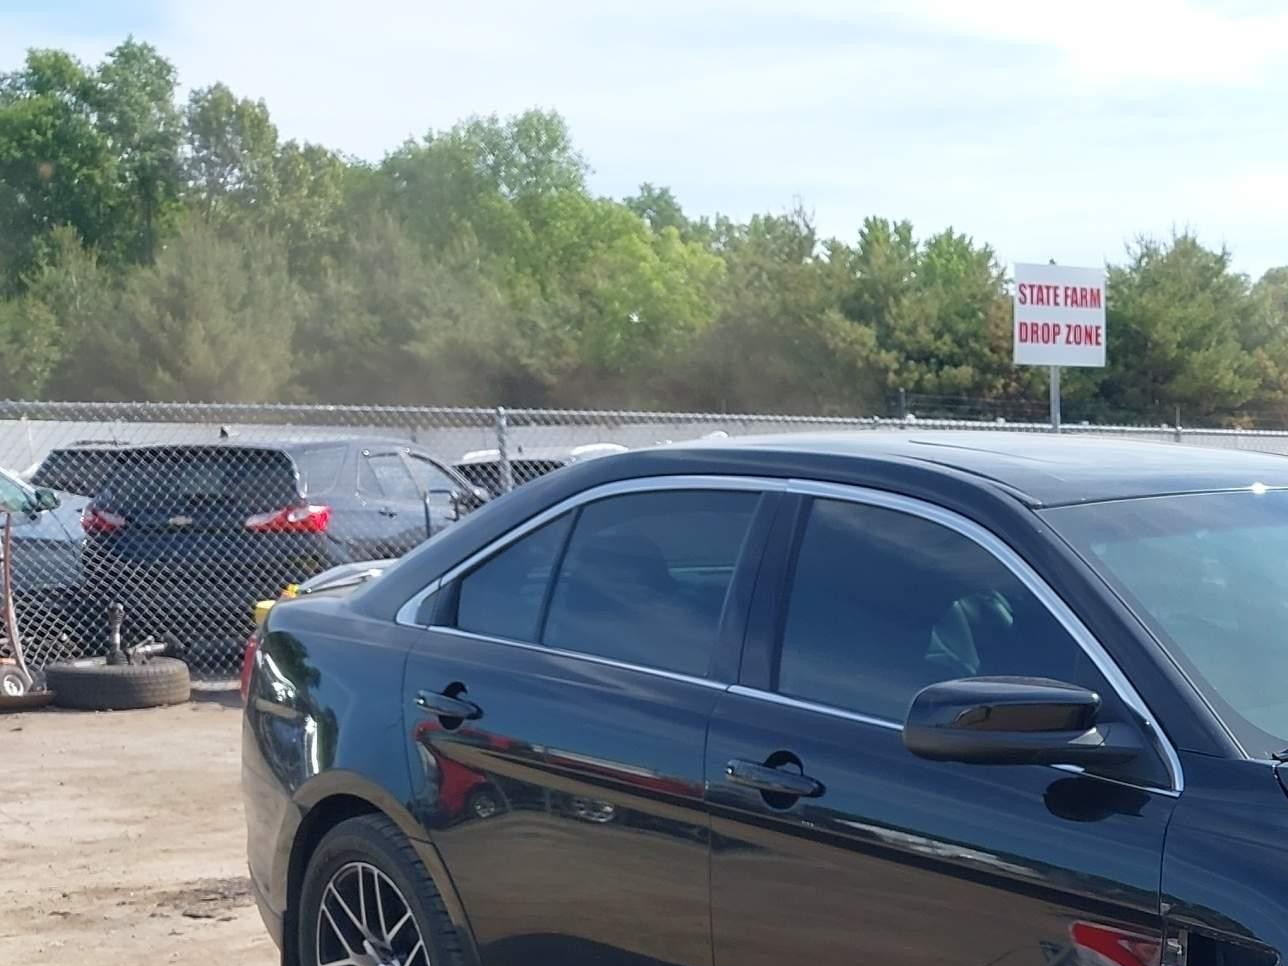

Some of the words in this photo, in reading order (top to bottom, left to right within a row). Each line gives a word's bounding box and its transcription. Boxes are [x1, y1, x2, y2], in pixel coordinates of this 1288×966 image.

[1018, 283, 1060, 307] STATE
[1064, 286, 1102, 309] FARM
[1019, 321, 1061, 345] DROP
[1065, 324, 1102, 347] ZONE
